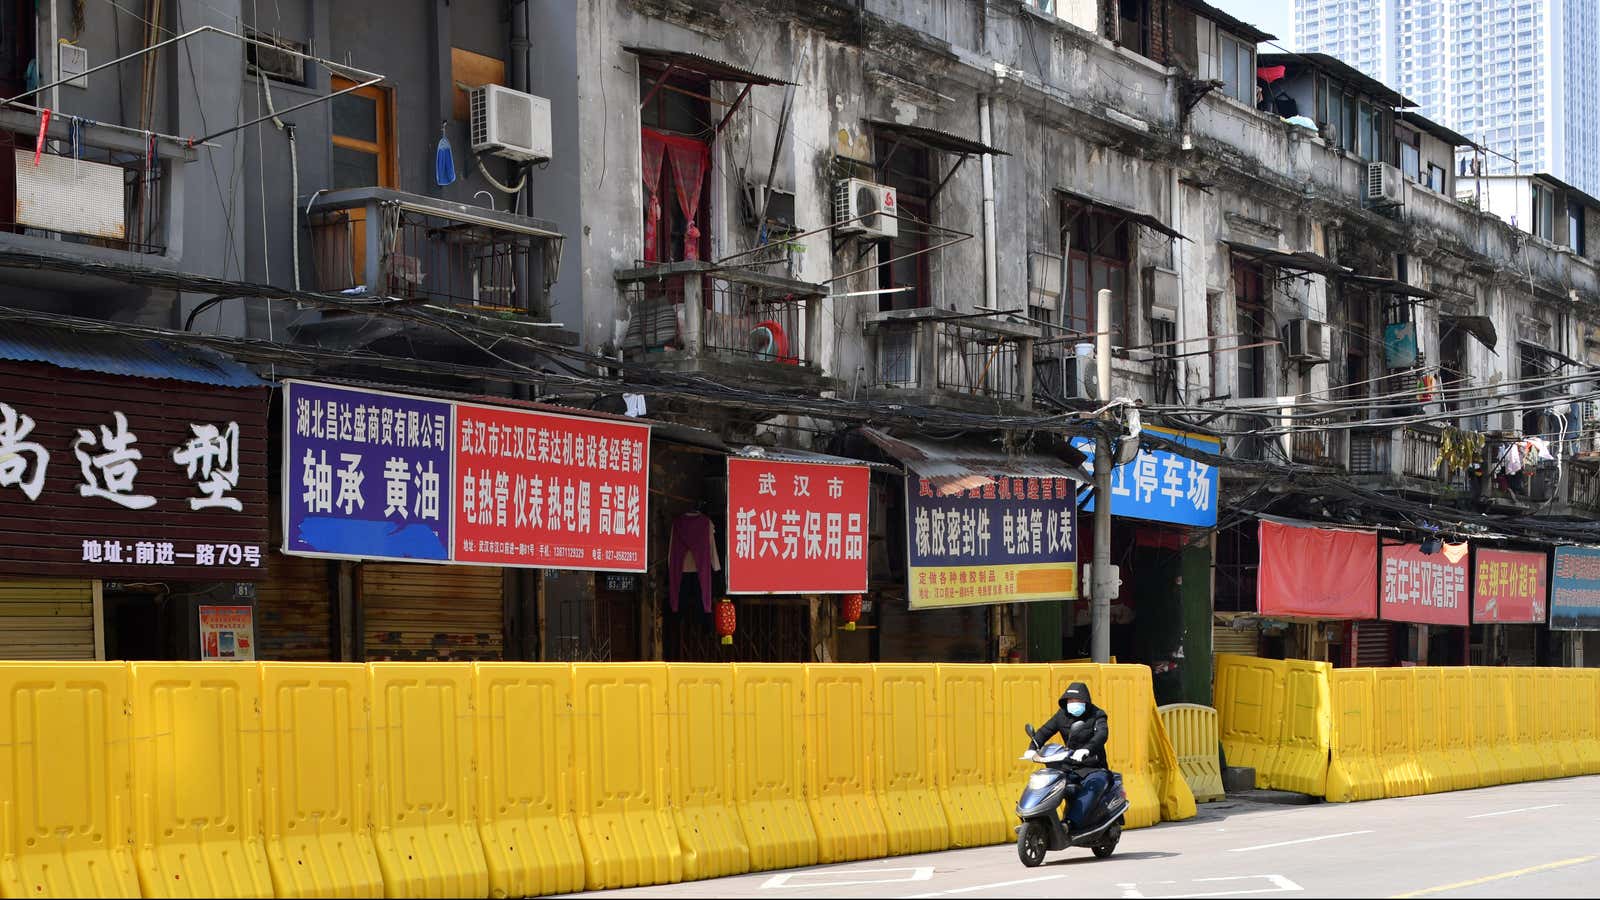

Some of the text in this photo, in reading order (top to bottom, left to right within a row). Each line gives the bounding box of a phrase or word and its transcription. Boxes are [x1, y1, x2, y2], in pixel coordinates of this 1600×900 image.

[297, 397, 446, 452] 湖北昌达盛商贸有限公司
[461, 418, 643, 474] 武汉市江汉区荣达机电设备经营部
[0, 402, 244, 512] 尚造型
[303, 448, 440, 521] 轴承 黄油
[463, 468, 641, 537] 电热管 仪表 热电偶 高温线
[758, 472, 844, 499] 武汉市
[82, 540, 262, 567] 地址:前进一路79号
[736, 507, 863, 560] 新兴劳保用品
[915, 506, 1073, 557] 橡胶密封件 电热管 仪表
[1478, 559, 1538, 599] 宏翔平价超市
